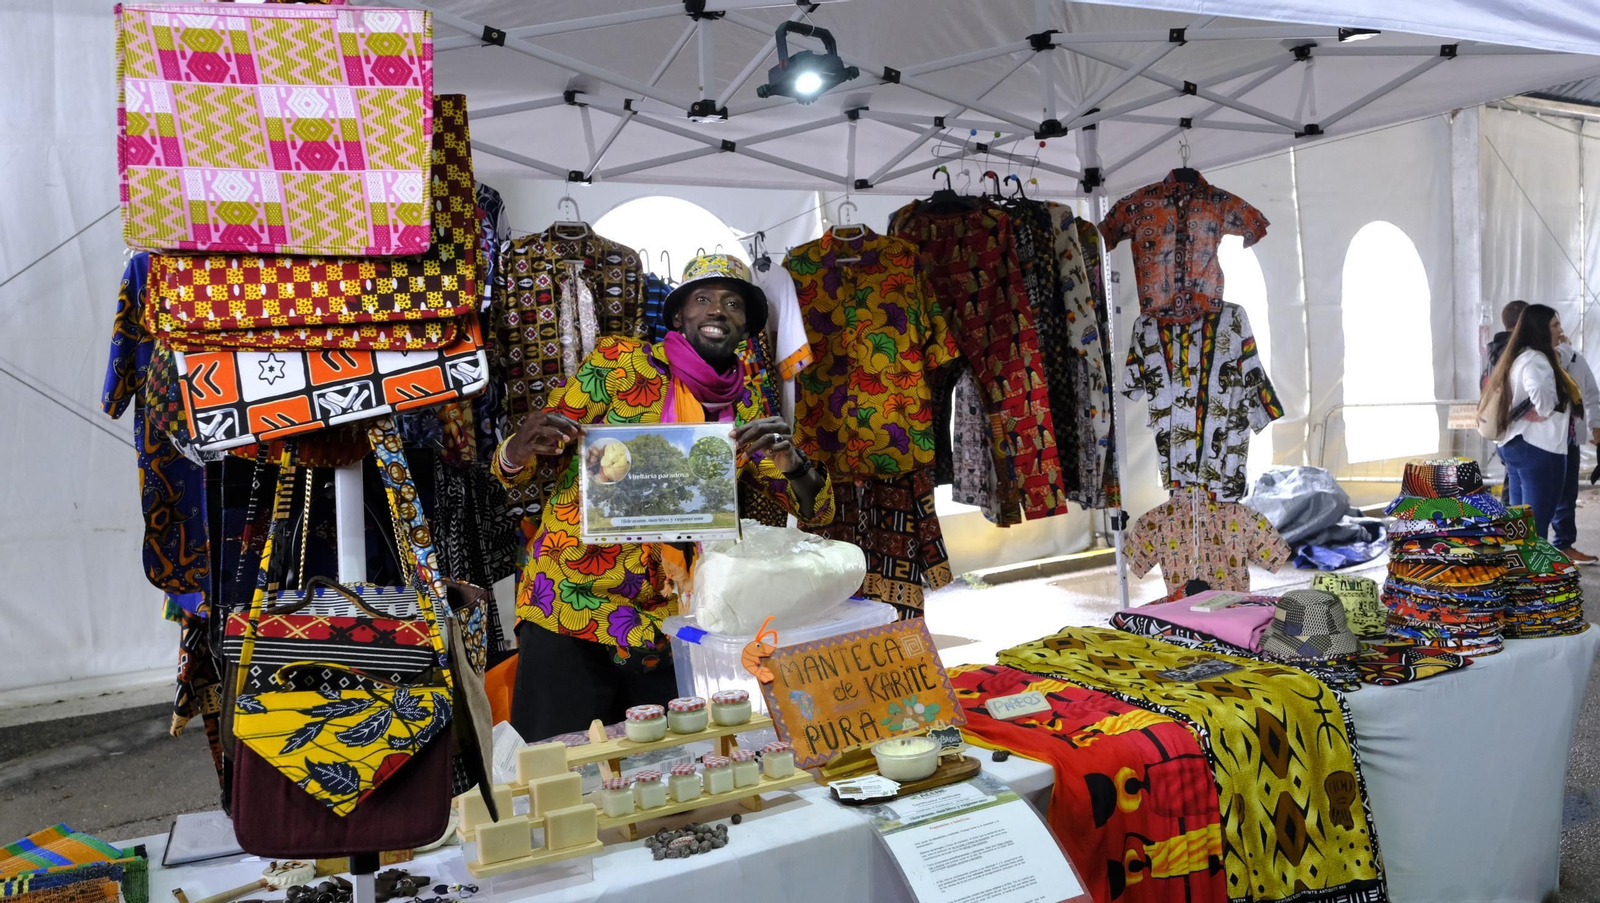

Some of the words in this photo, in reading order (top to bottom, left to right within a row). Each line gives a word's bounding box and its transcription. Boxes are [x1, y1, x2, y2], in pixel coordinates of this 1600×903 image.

[184, 6, 215, 15] PRINTS
[218, 7, 238, 16] WAX
[243, 8, 273, 17] BLOCK
[277, 9, 336, 18] GUARANTEED
[779, 637, 905, 688] MANTECA
[833, 680, 859, 702] de
[864, 656, 937, 703] KARITÉ
[993, 692, 1041, 714] PAREOS
[804, 711, 880, 755] PURA
